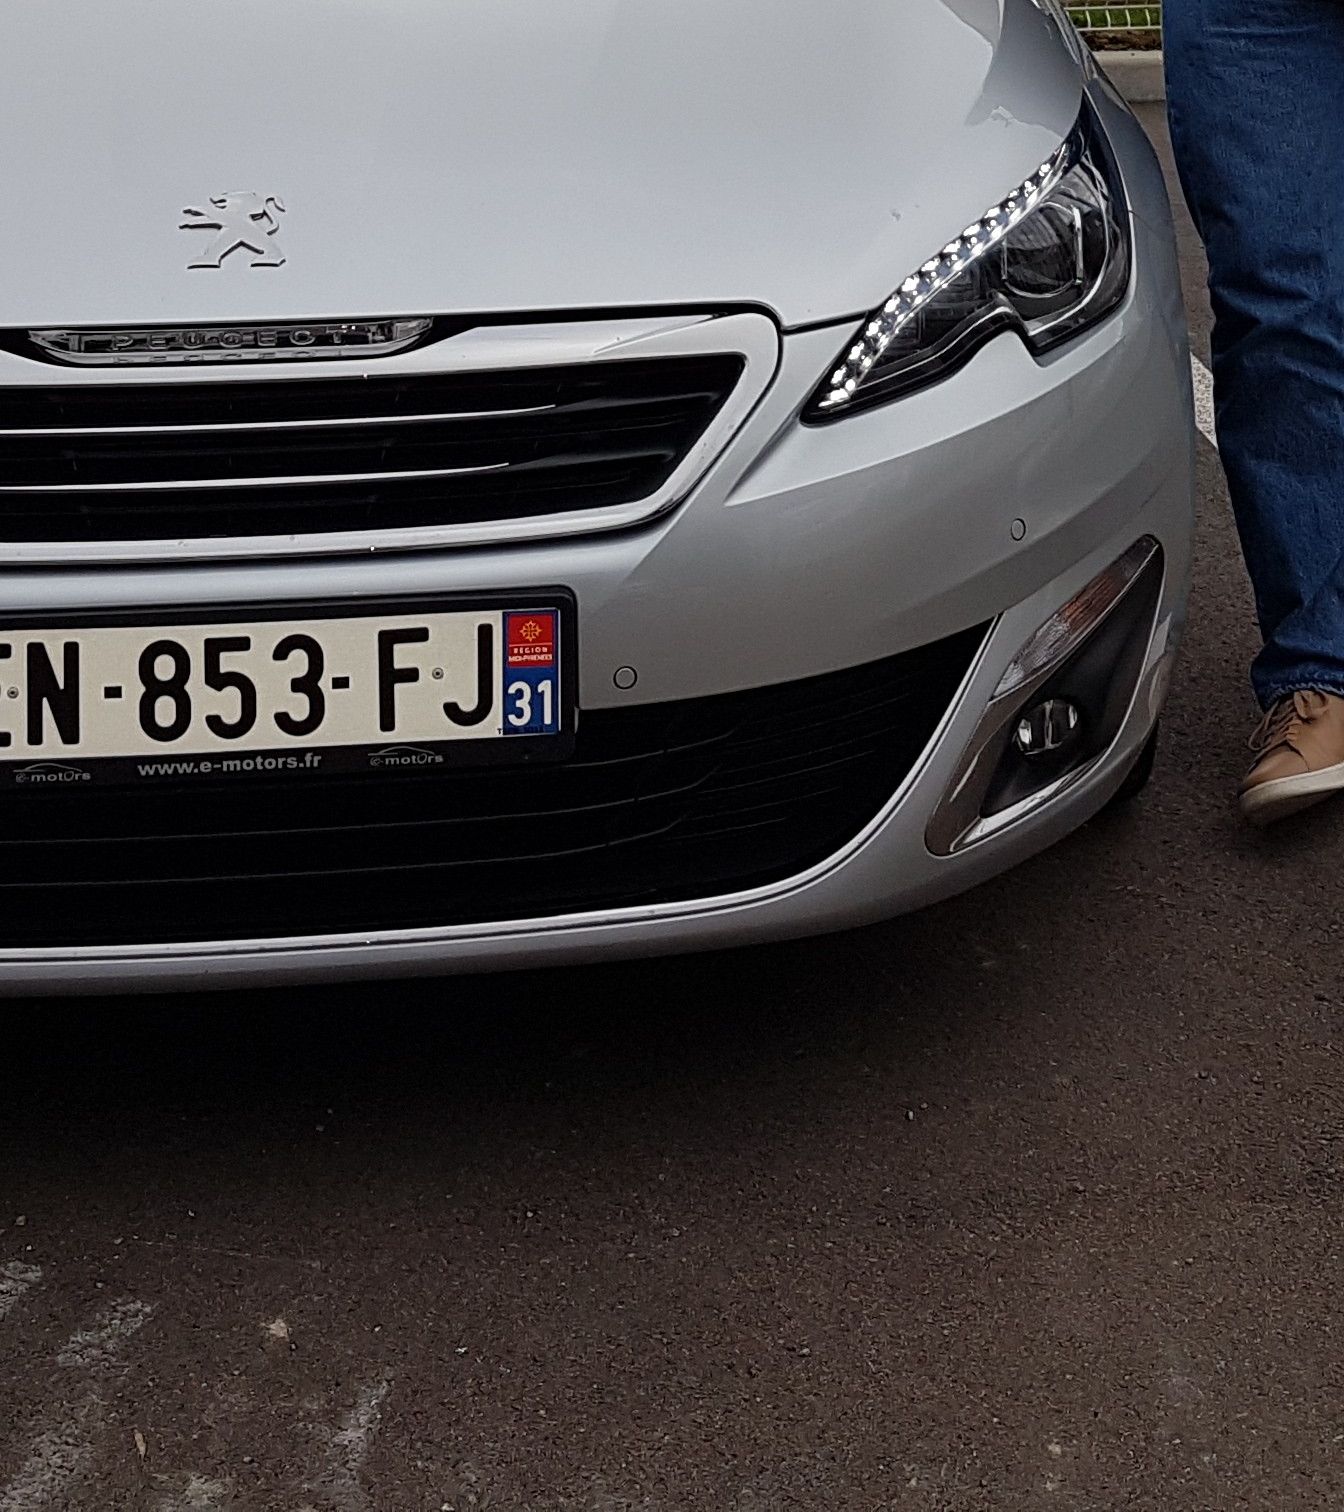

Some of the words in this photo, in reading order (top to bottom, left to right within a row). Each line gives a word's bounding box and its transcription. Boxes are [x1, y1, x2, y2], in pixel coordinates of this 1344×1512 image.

[112, 327, 348, 351] PEUGEOT
[508, 679, 552, 727] 31
[138, 752, 322, 777] www.e-motors.fr
